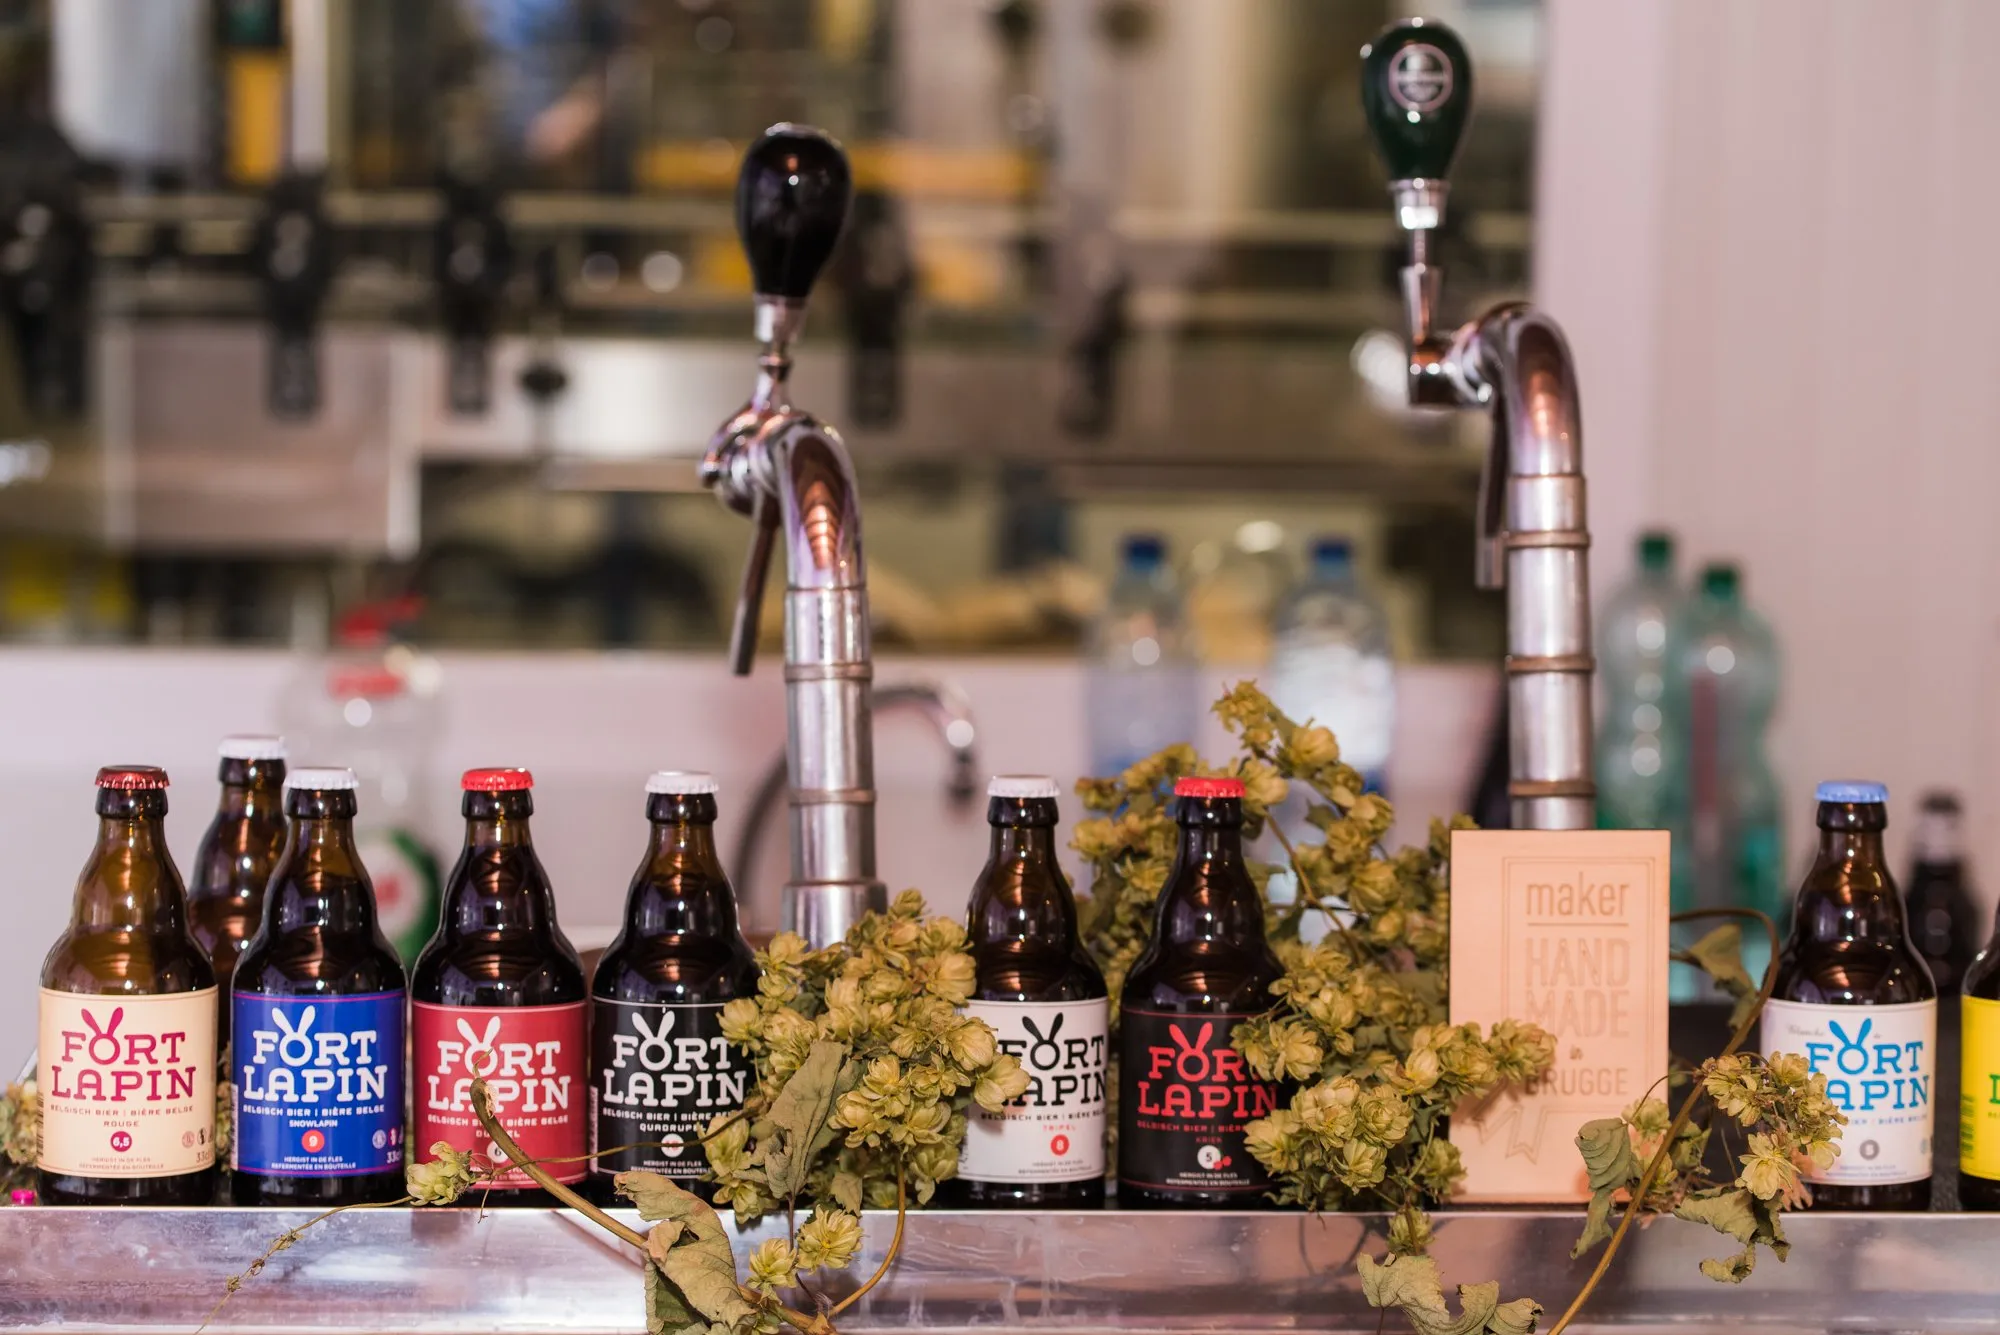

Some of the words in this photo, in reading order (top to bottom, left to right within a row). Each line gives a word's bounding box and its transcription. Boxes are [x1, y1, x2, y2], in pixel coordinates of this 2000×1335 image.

[1525, 871, 1630, 916] maker
[1525, 937, 1631, 987] HAND
[1525, 989, 1630, 1038] MADE
[61, 1007, 186, 1065] FORT
[252, 1005, 377, 1067] FORT
[437, 1015, 561, 1077] FORT
[612, 1010, 732, 1072] FORT
[998, 1012, 1105, 1071] FORT
[1148, 1021, 1247, 1082] FOR
[1806, 1017, 1923, 1075] FORT
[51, 1066, 197, 1101] LAPIN
[243, 1065, 388, 1103] LAPIN
[427, 1075, 572, 1113] LAPIN
[603, 1068, 747, 1107] LAPIN
[1002, 1069, 1107, 1107] APIN
[1137, 1081, 1277, 1118] LAPIN
[1526, 1067, 1629, 1096] BRUGGE
[1825, 1075, 1930, 1111] APIN
[50, 1104, 91, 1115] BELGISCH
[95, 1108, 119, 1116] BIER
[130, 1106, 161, 1116] BIÈRE
[165, 1105, 194, 1115] BELGE
[103, 1120, 140, 1128] ROUGE
[243, 1104, 283, 1116] BELGISCH
[286, 1107, 311, 1117] BIER
[321, 1105, 353, 1117] BIÈRE
[356, 1104, 385, 1115] BELGE
[288, 1119, 338, 1128] SNOWLAPIN
[427, 1114, 469, 1126] BELGISCH
[506, 1116, 537, 1127] BIÈRE
[540, 1114, 569, 1125] BELGE
[602, 1107, 643, 1120] BELGISCH
[646, 1112, 670, 1121] BIER
[681, 1110, 712, 1121] BIÈRE
[1036, 1113, 1059, 1121] BIER
[1137, 1119, 1180, 1131] BELGISCH
[1183, 1124, 1208, 1132] BIER
[111, 1136, 130, 1148] 6,5
[308, 1135, 319, 1147] 9
[1055, 1139, 1065, 1150] 8
[1205, 1151, 1213, 1162] 5
